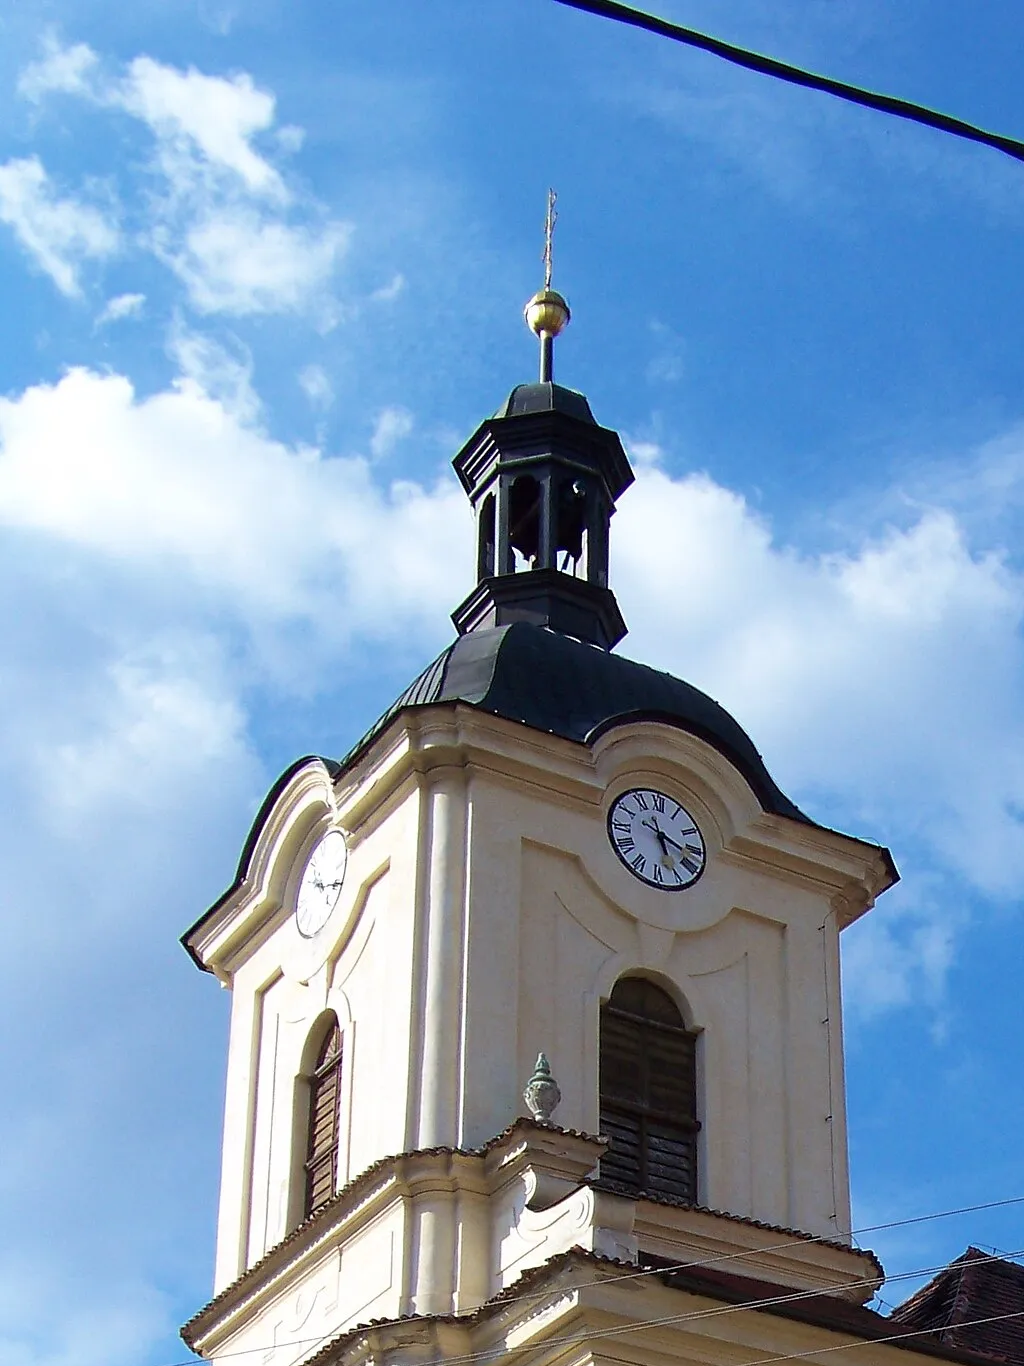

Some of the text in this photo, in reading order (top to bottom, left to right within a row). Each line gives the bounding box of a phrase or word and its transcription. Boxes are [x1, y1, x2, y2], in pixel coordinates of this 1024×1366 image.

[619, 802, 636, 820] X
[633, 793, 648, 812] XI
[651, 794, 665, 814] XII
[670, 807, 681, 820] I
[612, 818, 631, 834] IX
[681, 828, 697, 836] II
[616, 837, 635, 855] VIII
[631, 853, 647, 873] VII
[653, 863, 664, 882] VI
